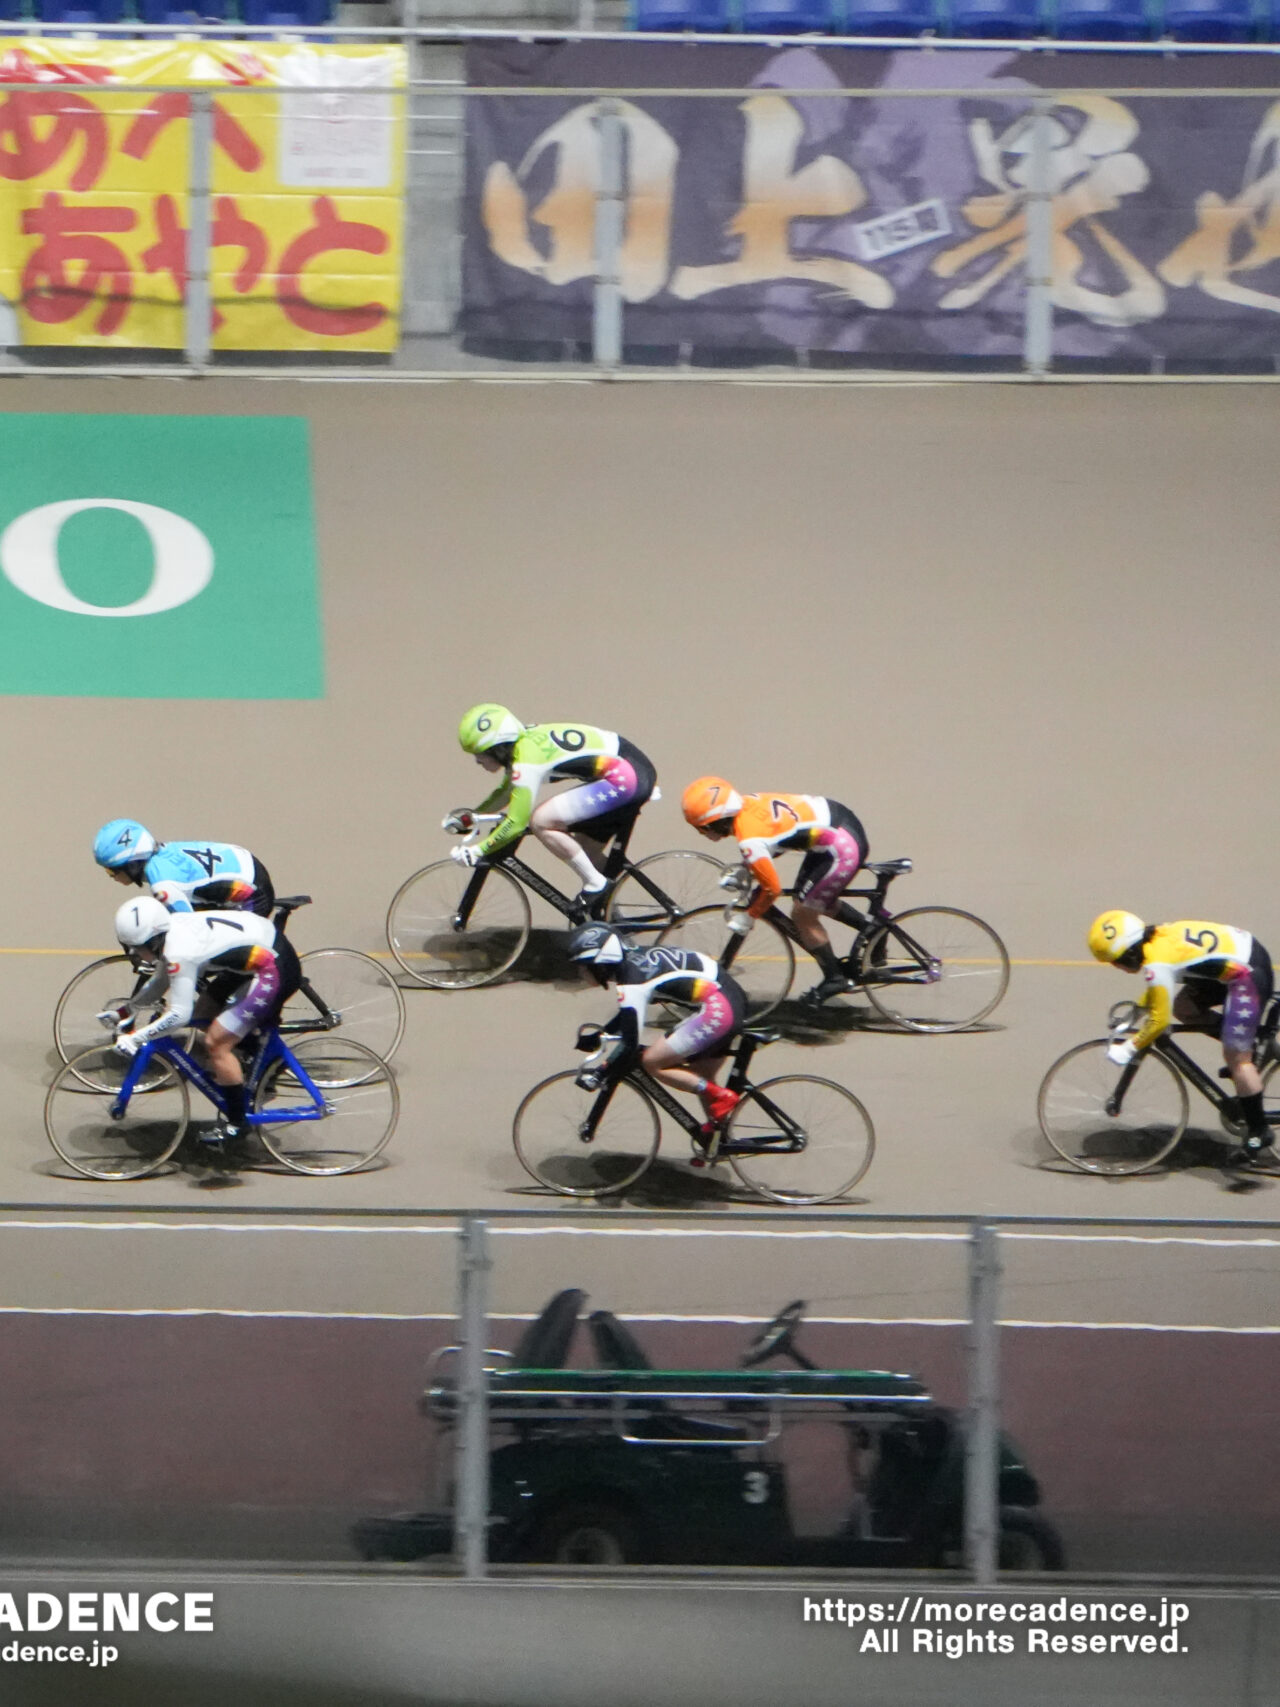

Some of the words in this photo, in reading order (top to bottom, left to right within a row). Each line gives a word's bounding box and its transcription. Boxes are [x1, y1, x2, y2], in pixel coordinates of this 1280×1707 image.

[20, 192, 391, 338] あやと
[477, 711, 492, 732] 6
[550, 729, 586, 752] 6
[708, 786, 721, 806] 7
[772, 799, 799, 822] 7
[117, 828, 133, 847] 4
[182, 848, 222, 878] 4
[131, 906, 140, 928] 1
[580, 926, 602, 949] 2
[1102, 920, 1117, 940] 5
[1185, 927, 1219, 953] 5
[645, 947, 688, 971] 2
[742, 1471, 770, 1504] 3
